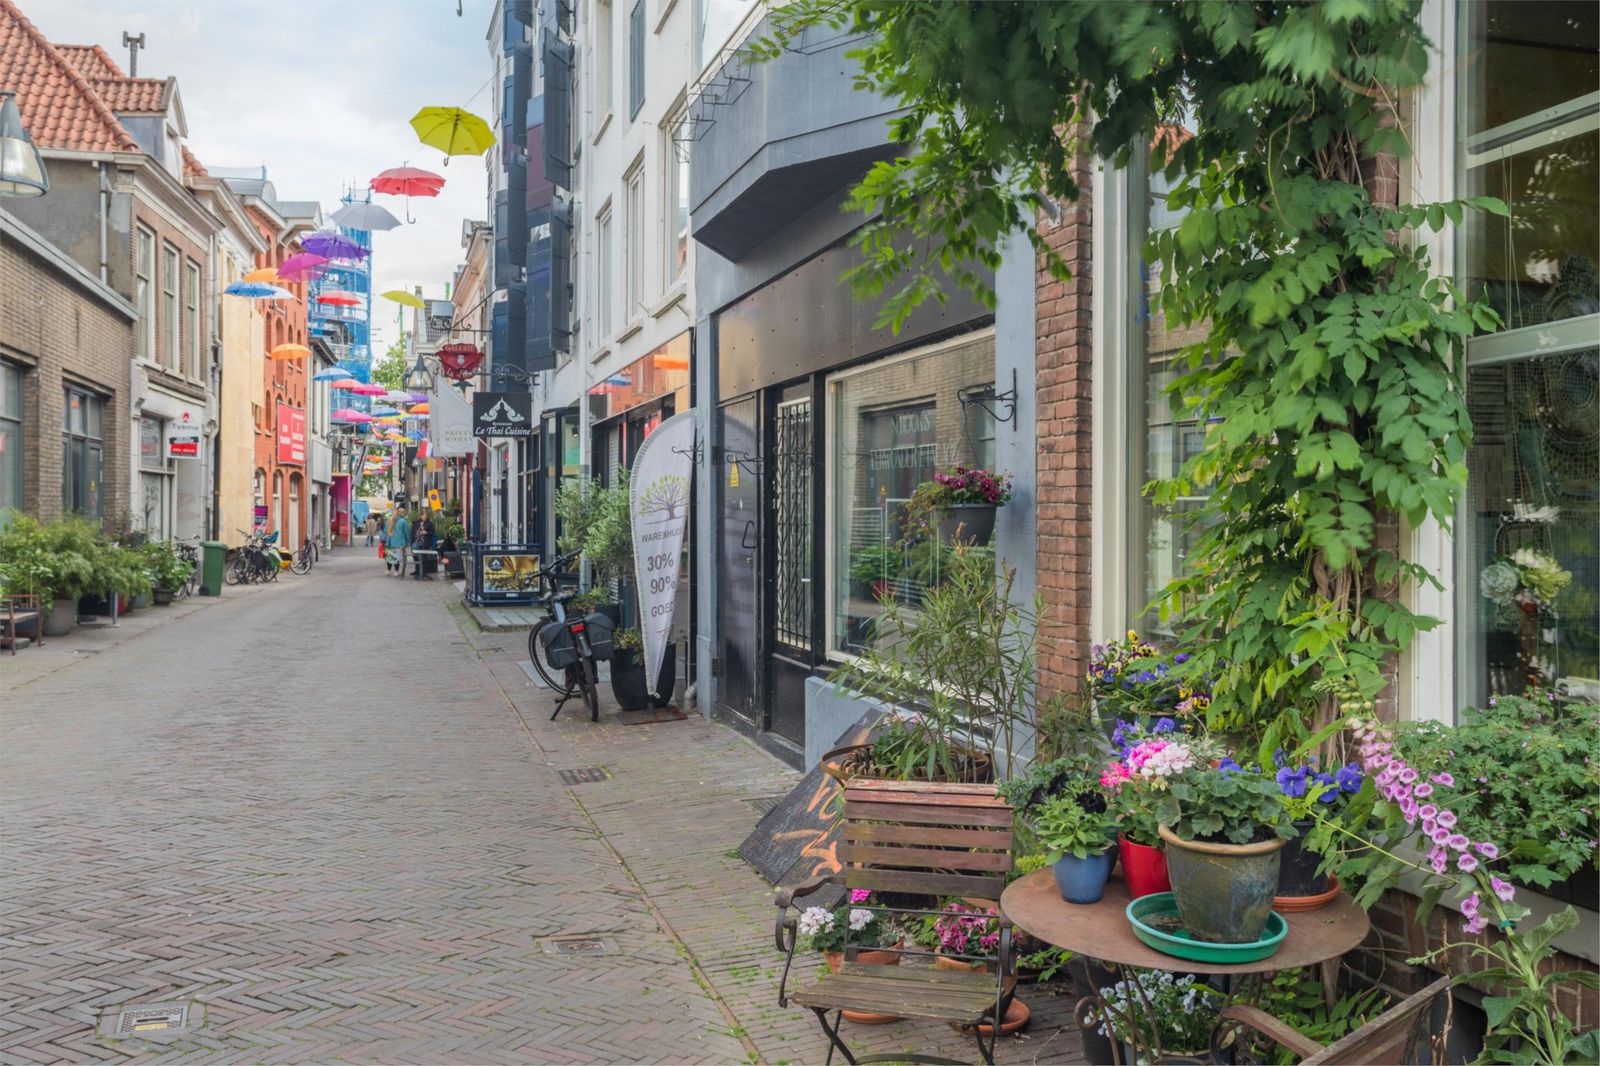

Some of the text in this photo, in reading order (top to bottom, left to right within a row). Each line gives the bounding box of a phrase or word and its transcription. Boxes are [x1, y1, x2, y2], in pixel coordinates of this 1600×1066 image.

[475, 425, 531, 436] Le Thai Cuisine
[647, 552, 674, 572] 30%
[650, 575, 676, 595] 90%
